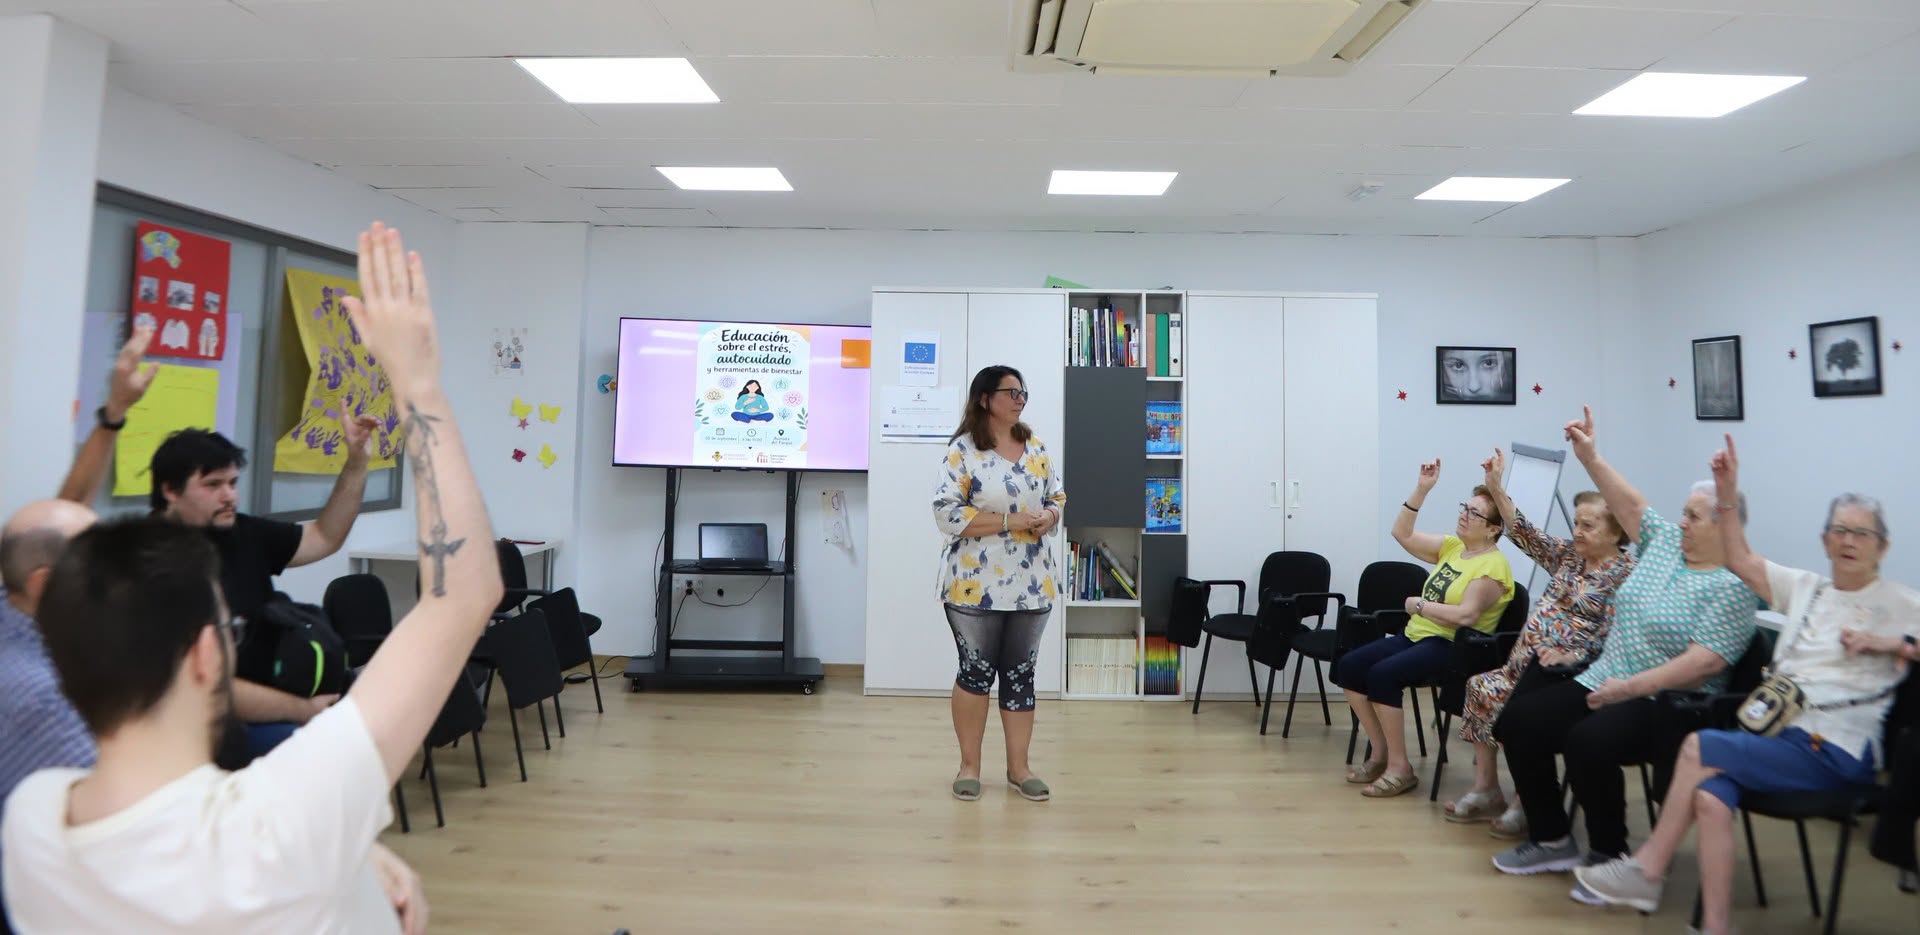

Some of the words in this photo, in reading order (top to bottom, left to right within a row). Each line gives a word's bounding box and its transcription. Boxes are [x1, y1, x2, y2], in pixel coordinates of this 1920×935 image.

[721, 329, 790, 343] Educación
[717, 343, 745, 351] sobre
[748, 343, 757, 351] el
[759, 344, 792, 354] estrés,
[717, 353, 791, 365] autocuidado
